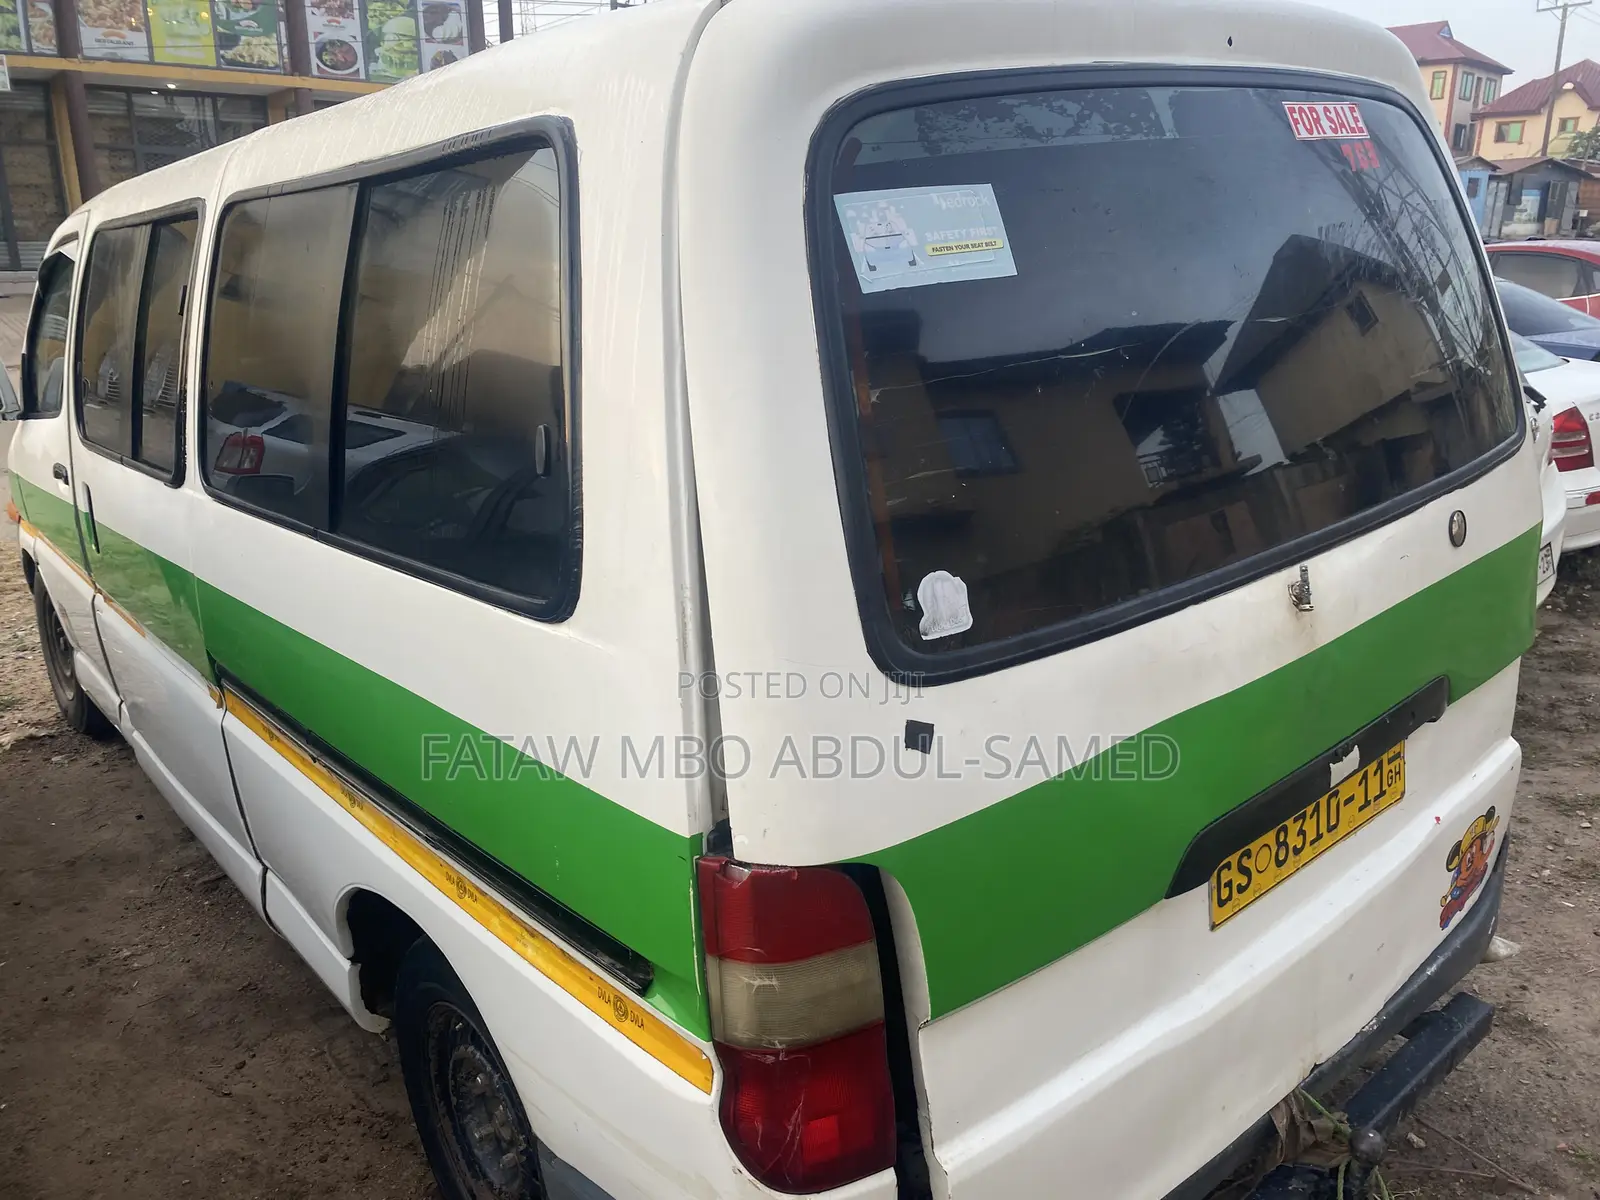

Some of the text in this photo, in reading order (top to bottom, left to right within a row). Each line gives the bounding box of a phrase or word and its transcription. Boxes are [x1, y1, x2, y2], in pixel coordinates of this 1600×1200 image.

[1286, 105, 1366, 136] FOR SALE
[925, 226, 998, 242] SAFETY FIRST
[931, 245, 954, 253] FASTEN
[954, 243, 971, 251] YOUR
[1216, 759, 1402, 908] GS 8310-11 GH
[597, 986, 645, 1032] DVLA DVLA
